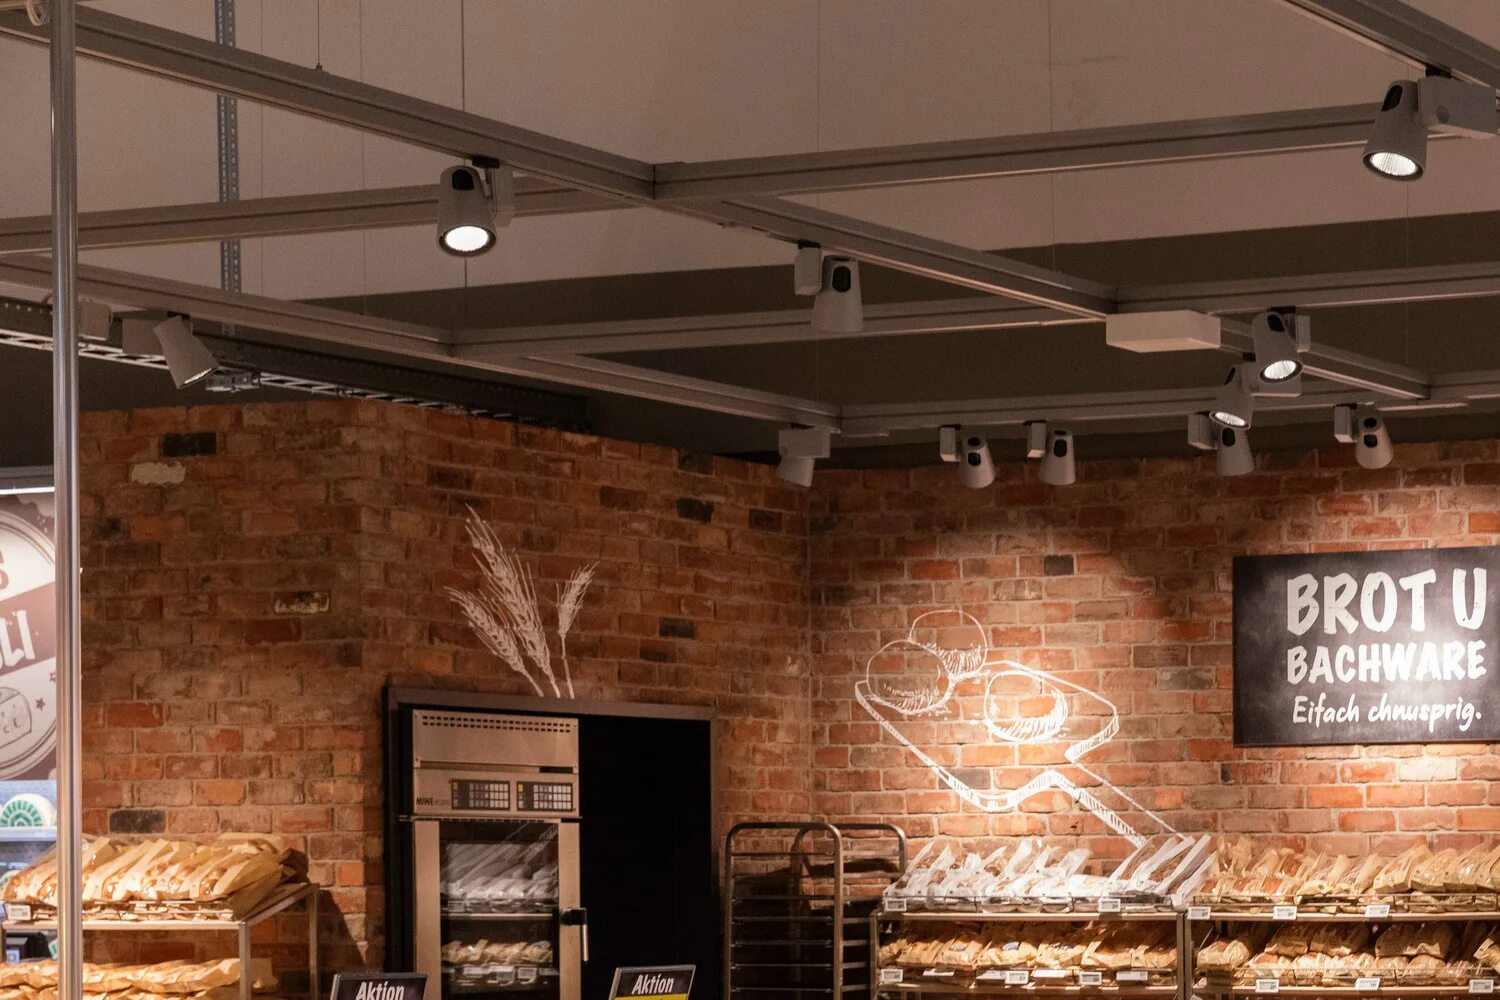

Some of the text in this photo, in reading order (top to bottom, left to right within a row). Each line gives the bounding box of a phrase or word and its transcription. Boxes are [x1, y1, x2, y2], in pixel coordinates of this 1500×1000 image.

[1287, 567, 1487, 636] BROT U
[1287, 639, 1487, 685] BACHWARE
[1293, 692, 1482, 733] Eifach chnusprig.
[631, 973, 674, 995] Aktion
